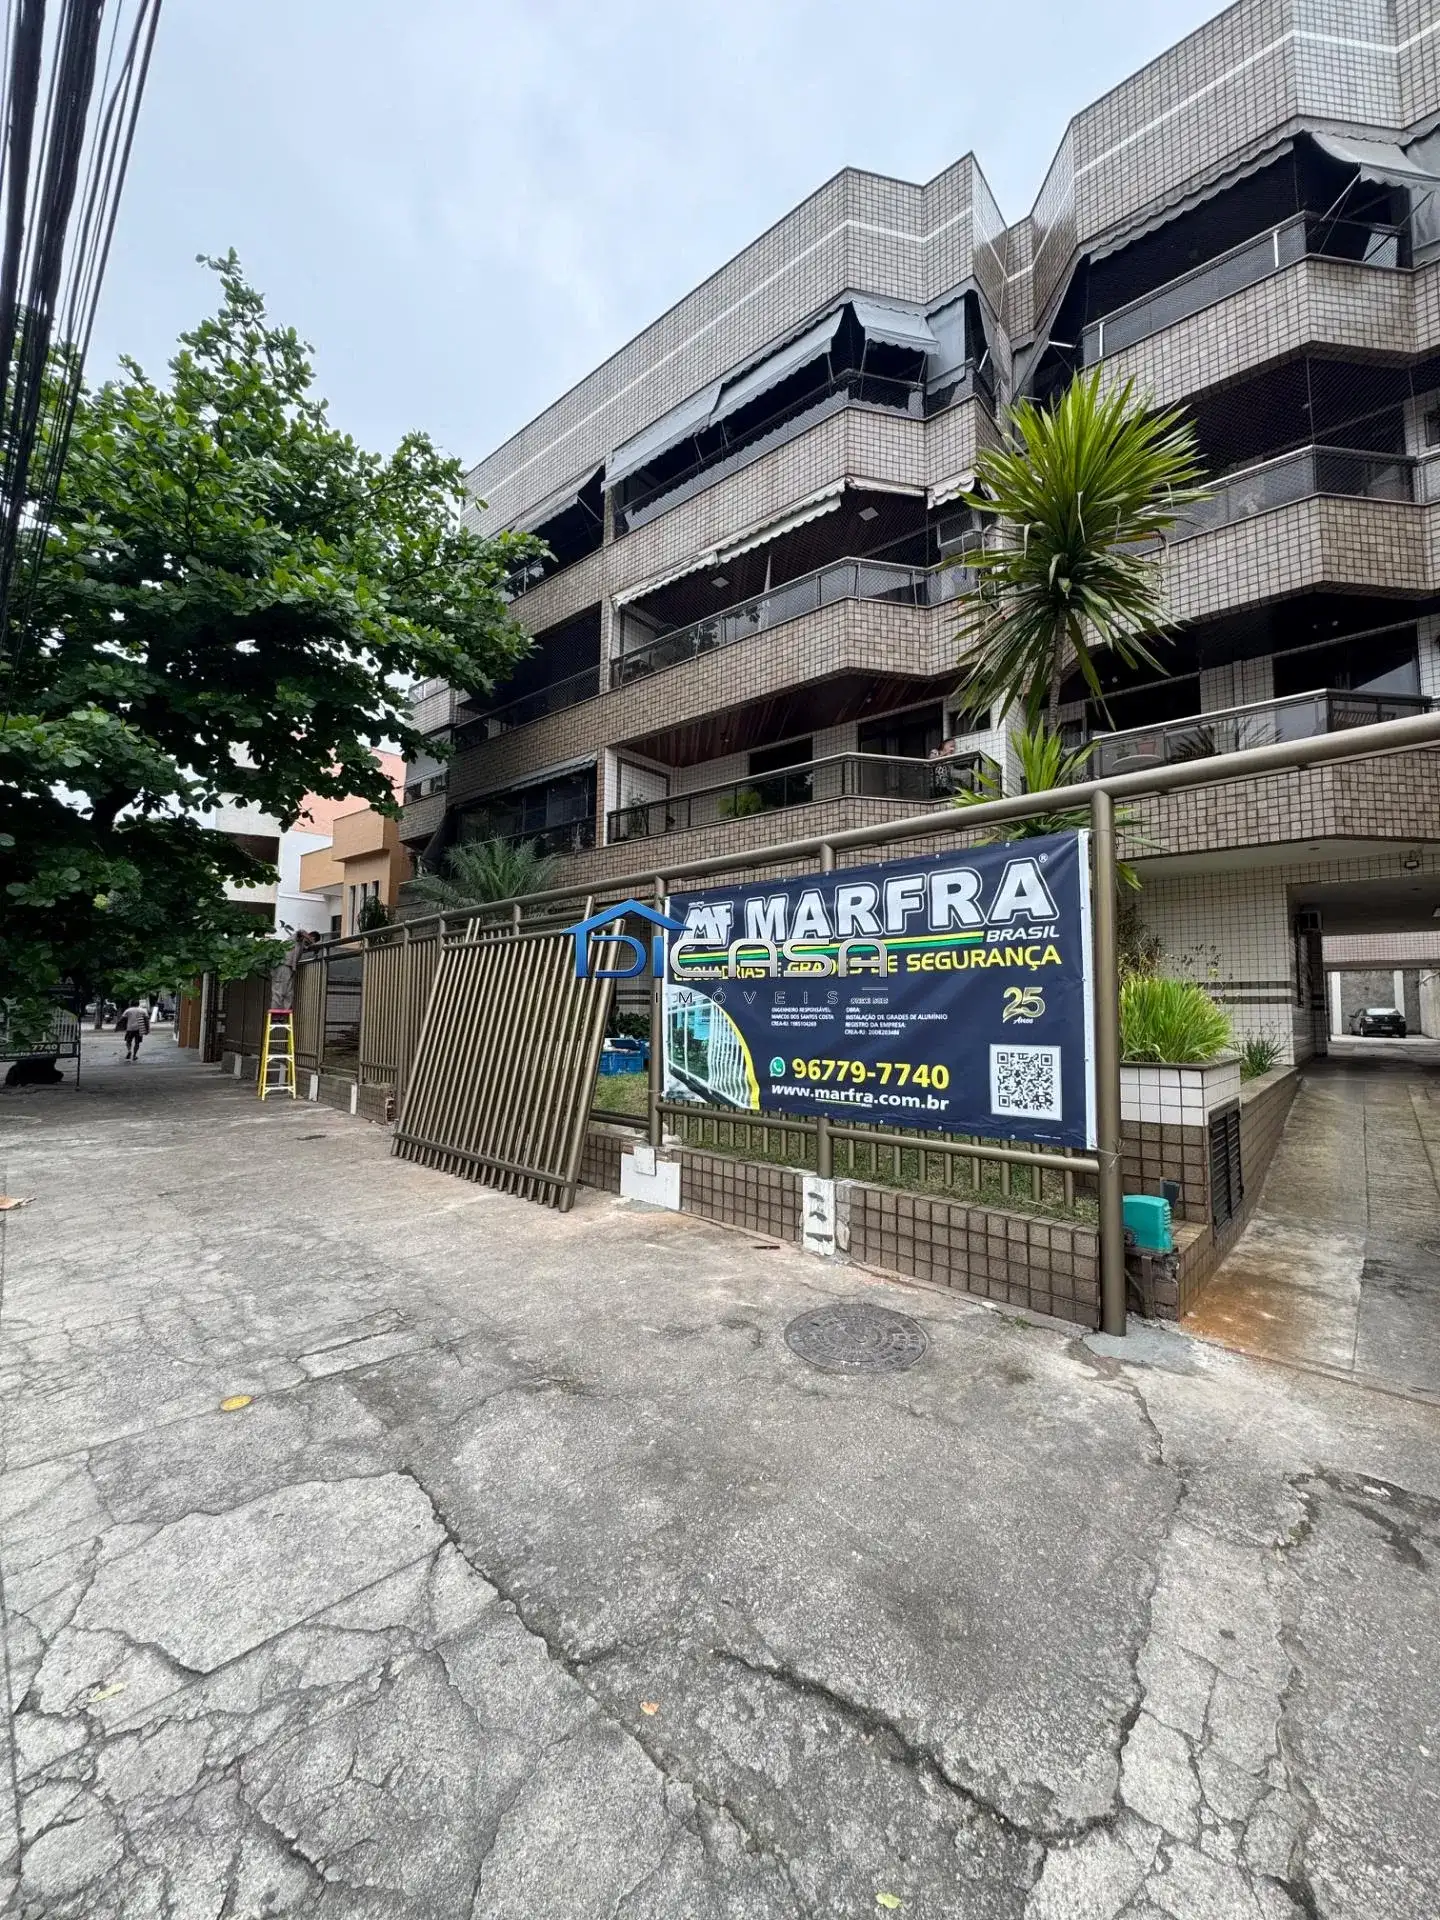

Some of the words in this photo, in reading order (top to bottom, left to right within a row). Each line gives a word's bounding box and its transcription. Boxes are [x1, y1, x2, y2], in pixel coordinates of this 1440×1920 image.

[744, 857, 1060, 943] MARFRA
[986, 926, 1060, 943] BRASIL
[906, 945, 1062, 972] SEGURANÇA
[918, 1012, 948, 1020] ALUMÍNIO
[1002, 987, 1046, 1023] 25
[791, 1058, 950, 1090] 96779-7740
[771, 1084, 950, 1111] www.marfra.com.br
